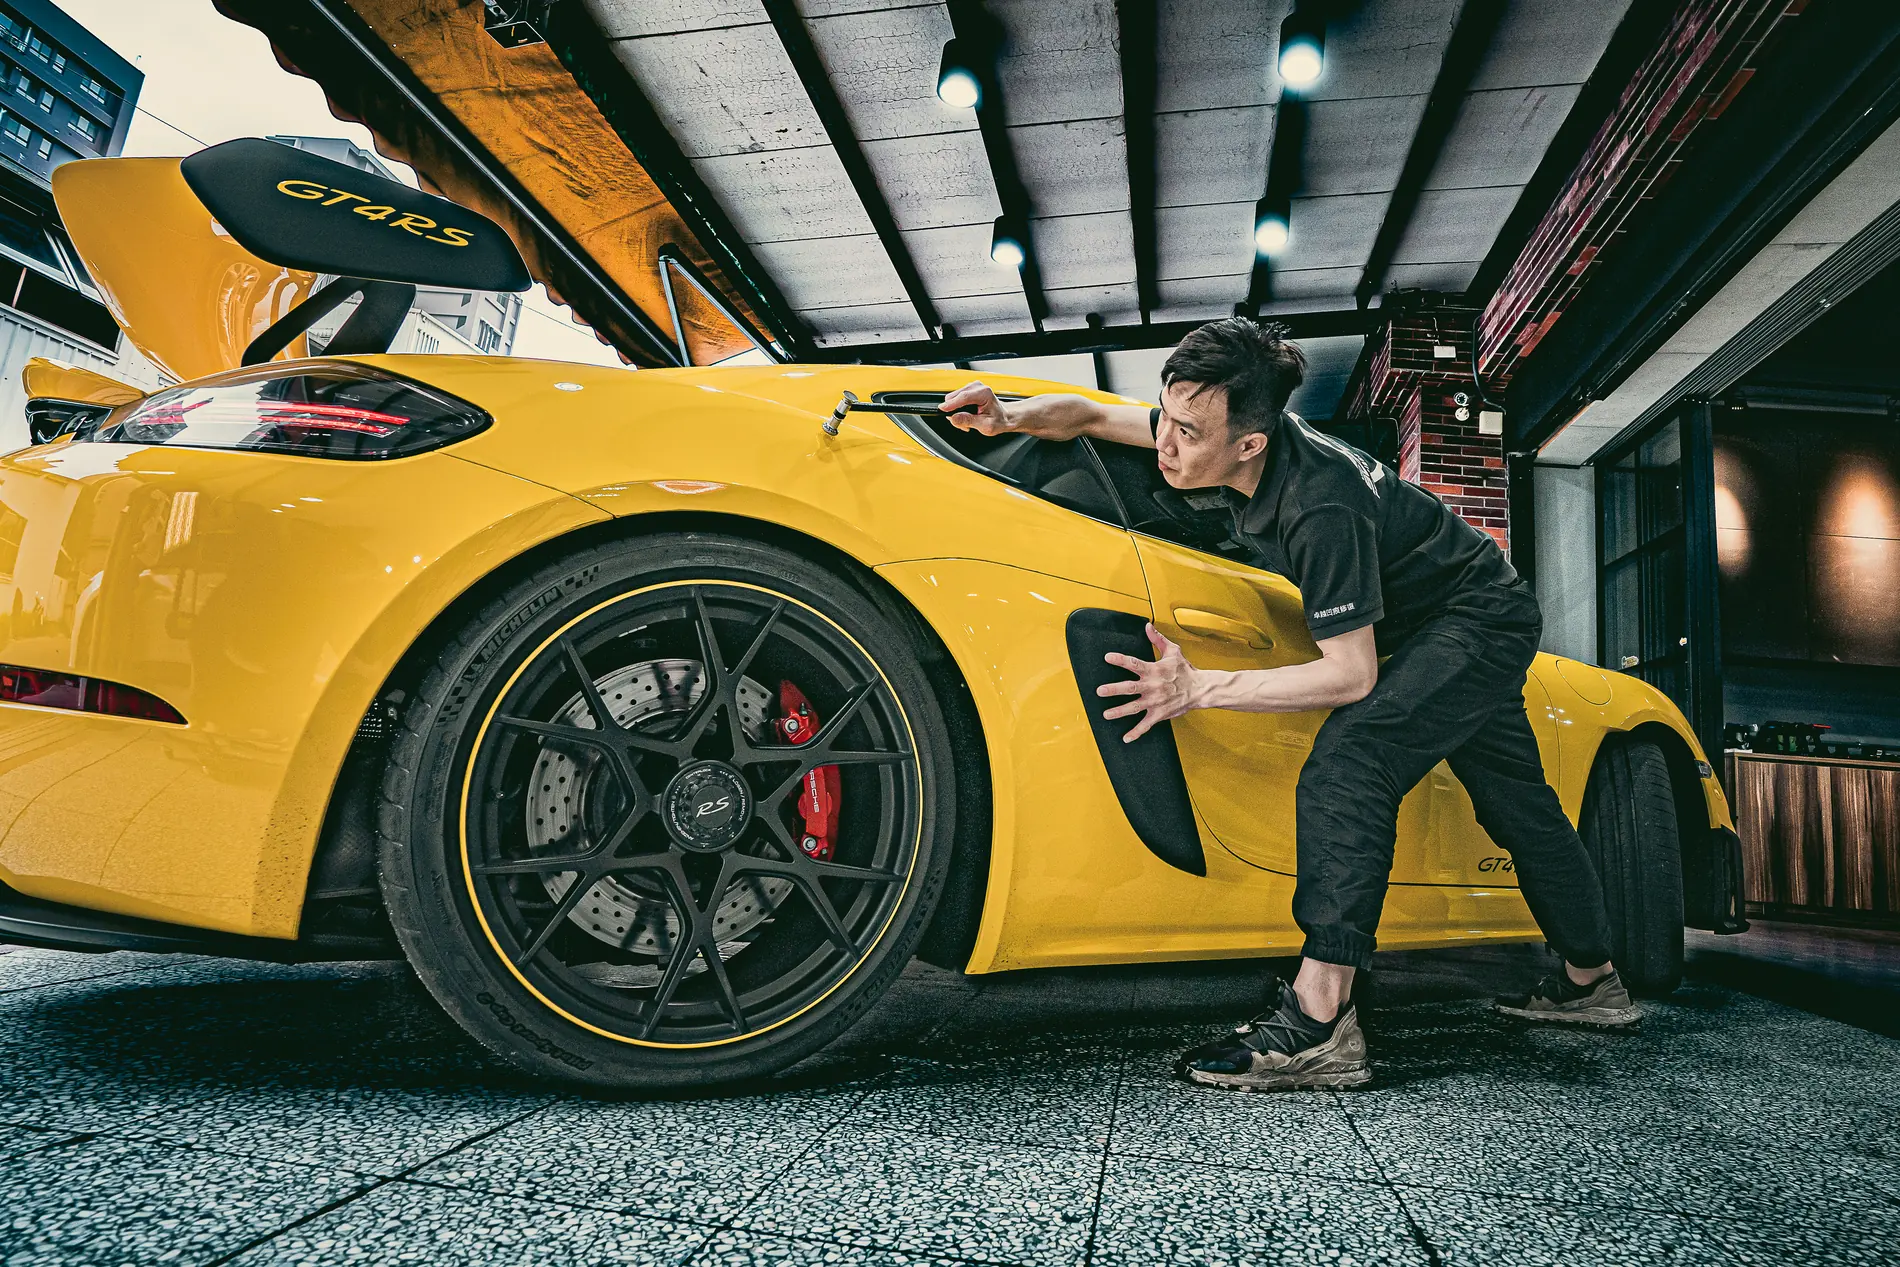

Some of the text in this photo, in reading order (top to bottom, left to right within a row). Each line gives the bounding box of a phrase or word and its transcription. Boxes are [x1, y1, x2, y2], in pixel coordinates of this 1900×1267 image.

[480, 586, 564, 663] MICHELIN
[696, 796, 730, 818] RS
[1477, 857, 1515, 873] GT4
